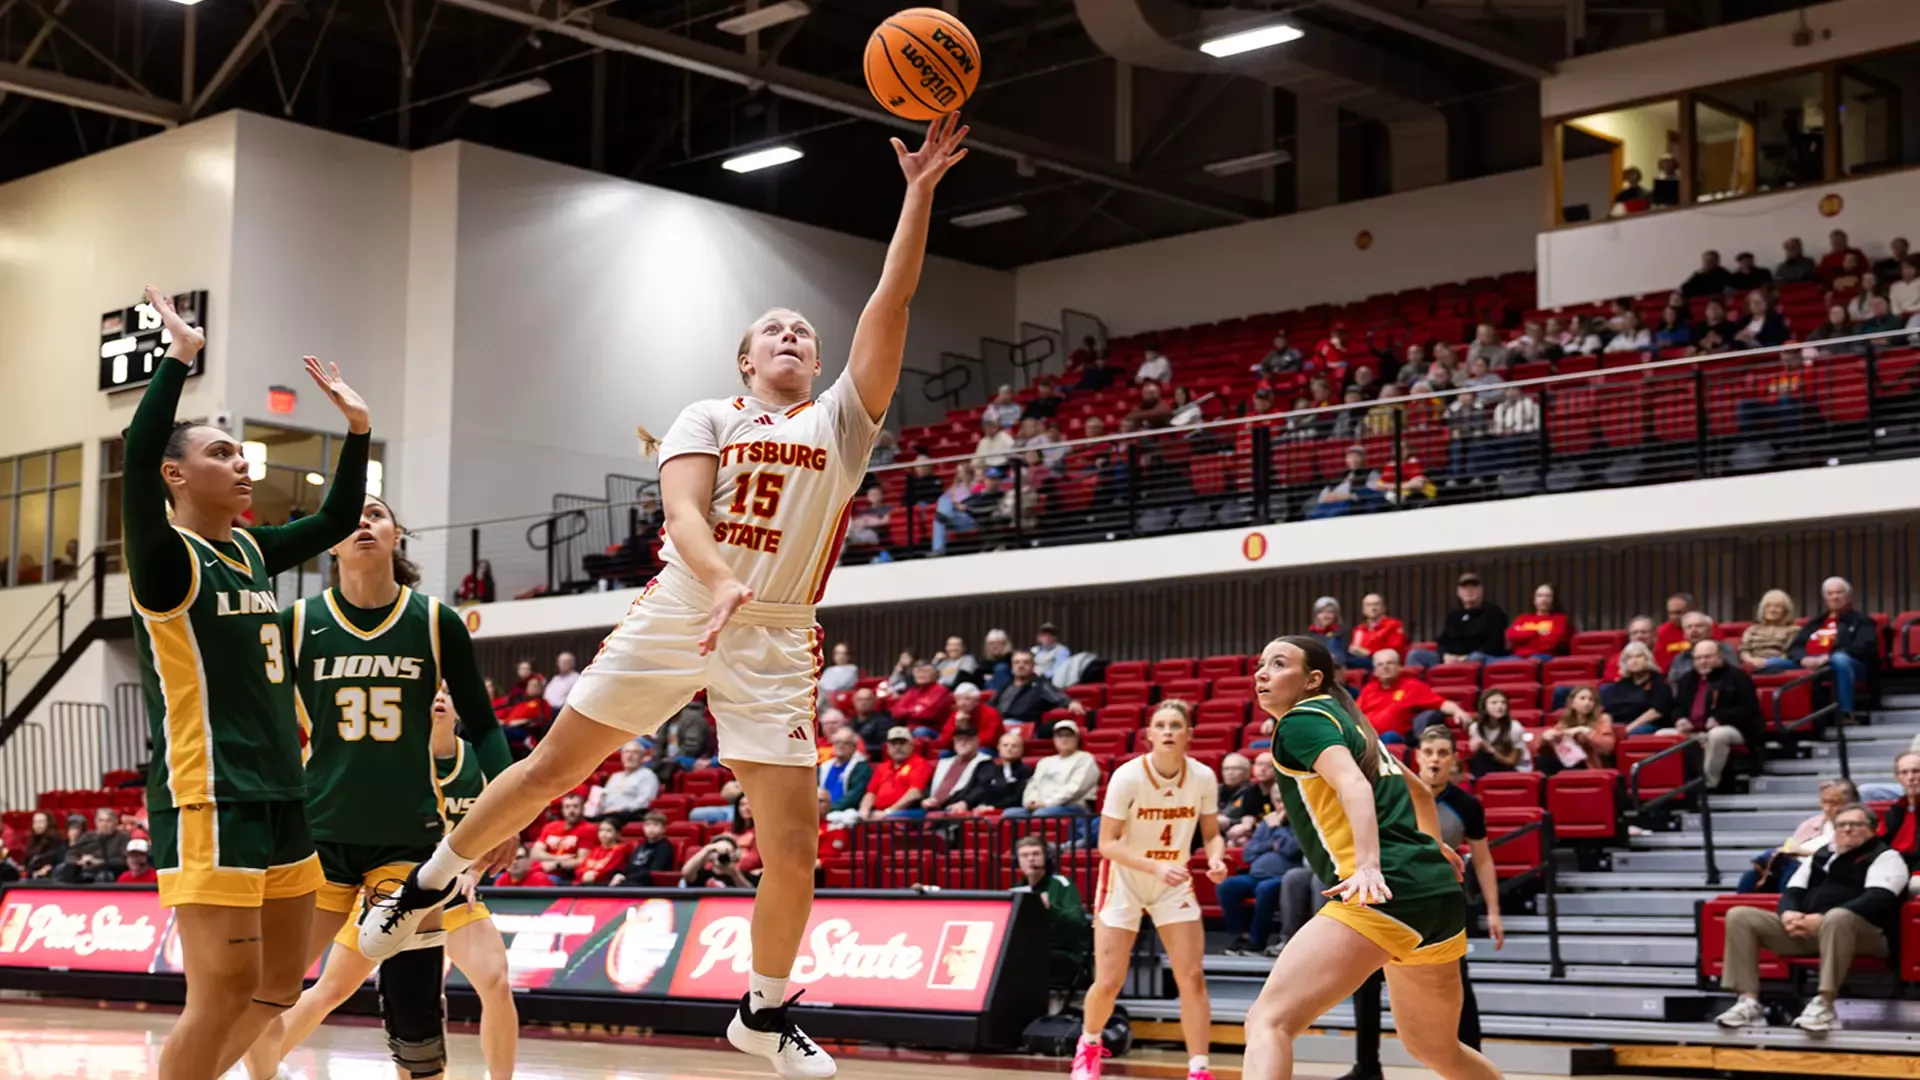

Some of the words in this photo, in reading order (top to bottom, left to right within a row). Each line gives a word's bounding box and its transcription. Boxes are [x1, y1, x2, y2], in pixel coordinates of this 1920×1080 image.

[932, 28, 974, 74] NCAA
[901, 43, 957, 107] Wilson
[720, 441, 827, 471] TTSBURG
[728, 471, 786, 520] 15
[713, 521, 783, 555] STATE
[216, 589, 279, 616] LION
[259, 623, 285, 684] 3
[313, 655, 424, 682] LIONS
[335, 686, 402, 742] 35
[1160, 823, 1172, 847] 4
[788, 918, 923, 984] State
